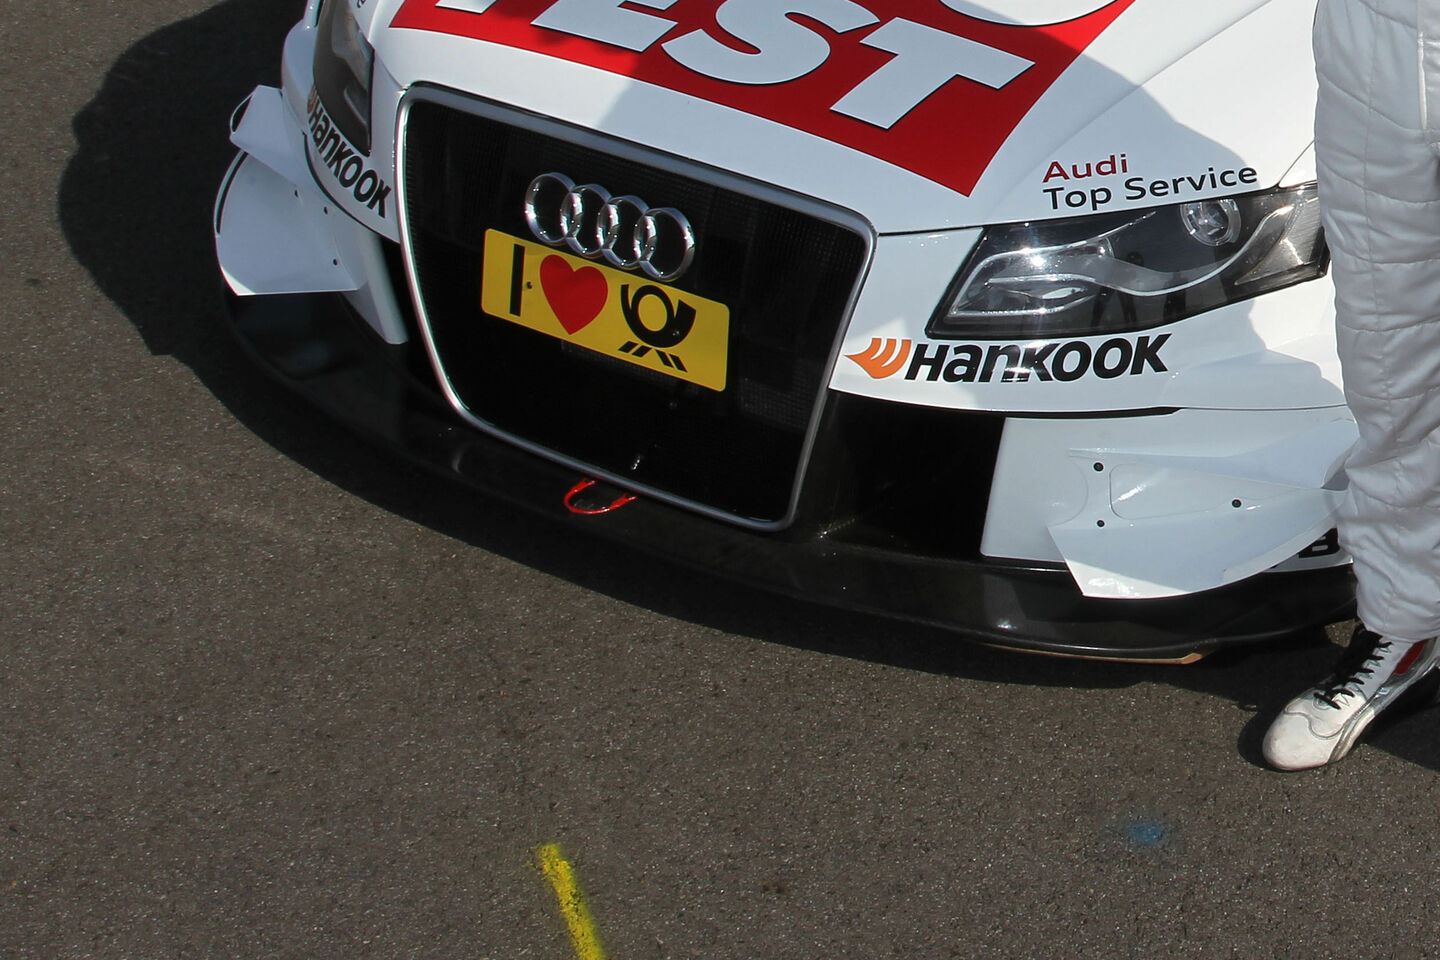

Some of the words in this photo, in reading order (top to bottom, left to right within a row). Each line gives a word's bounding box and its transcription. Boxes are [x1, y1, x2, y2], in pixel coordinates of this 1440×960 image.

[1042, 153, 1130, 184] Audi
[1043, 186, 1112, 211] Top
[1124, 166, 1258, 201] Service
[509, 243, 526, 317] I
